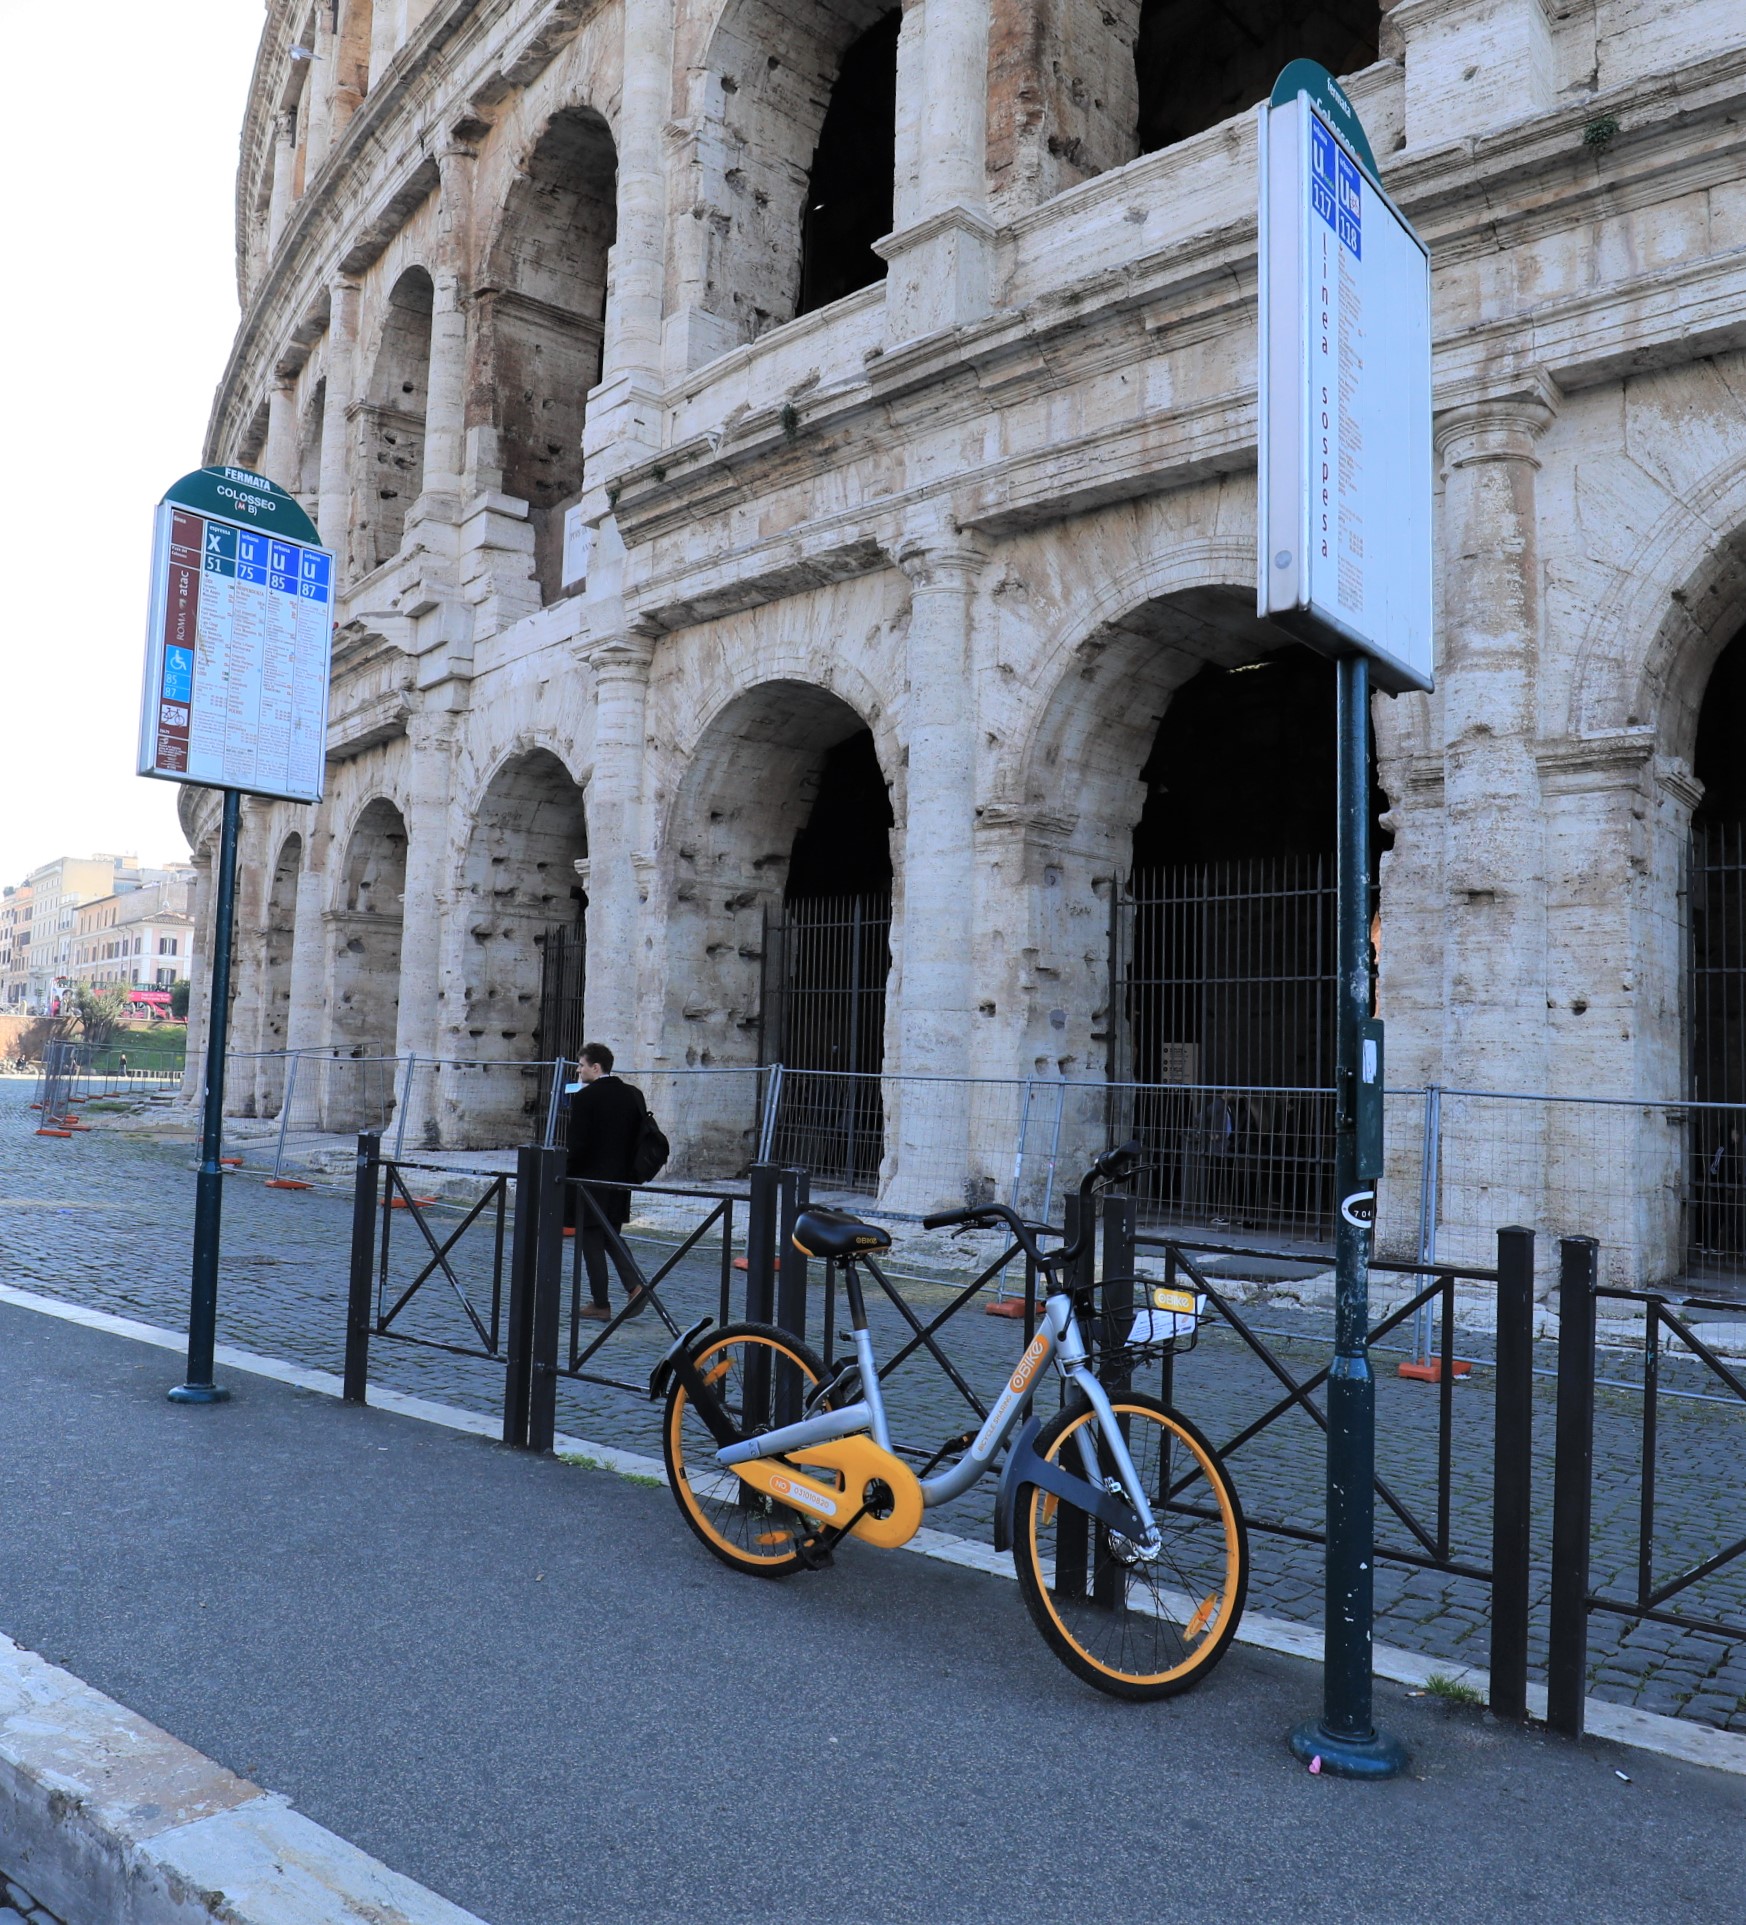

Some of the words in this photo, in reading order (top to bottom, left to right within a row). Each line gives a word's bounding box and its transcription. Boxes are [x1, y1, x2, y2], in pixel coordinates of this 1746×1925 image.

[1327, 77, 1351, 119] fermata
[1313, 183, 1332, 220] 117
[1340, 215, 1357, 252] 118
[225, 467, 271, 492] FERMATA
[217, 485, 276, 511] COLOSSEO
[209, 525, 231, 536] espressa
[241, 533, 259, 543] urbana
[207, 556, 221, 573] 51
[240, 564, 254, 580] 75
[179, 570, 189, 597] atac
[270, 575, 285, 590] 85
[301, 583, 316, 598] 87
[176, 612, 187, 641] ROMA
[165, 673, 178, 685] 85
[164, 687, 177, 698] 87
[978, 1422, 997, 1452] BICYCLE
[992, 1395, 1012, 1425] SHARING
